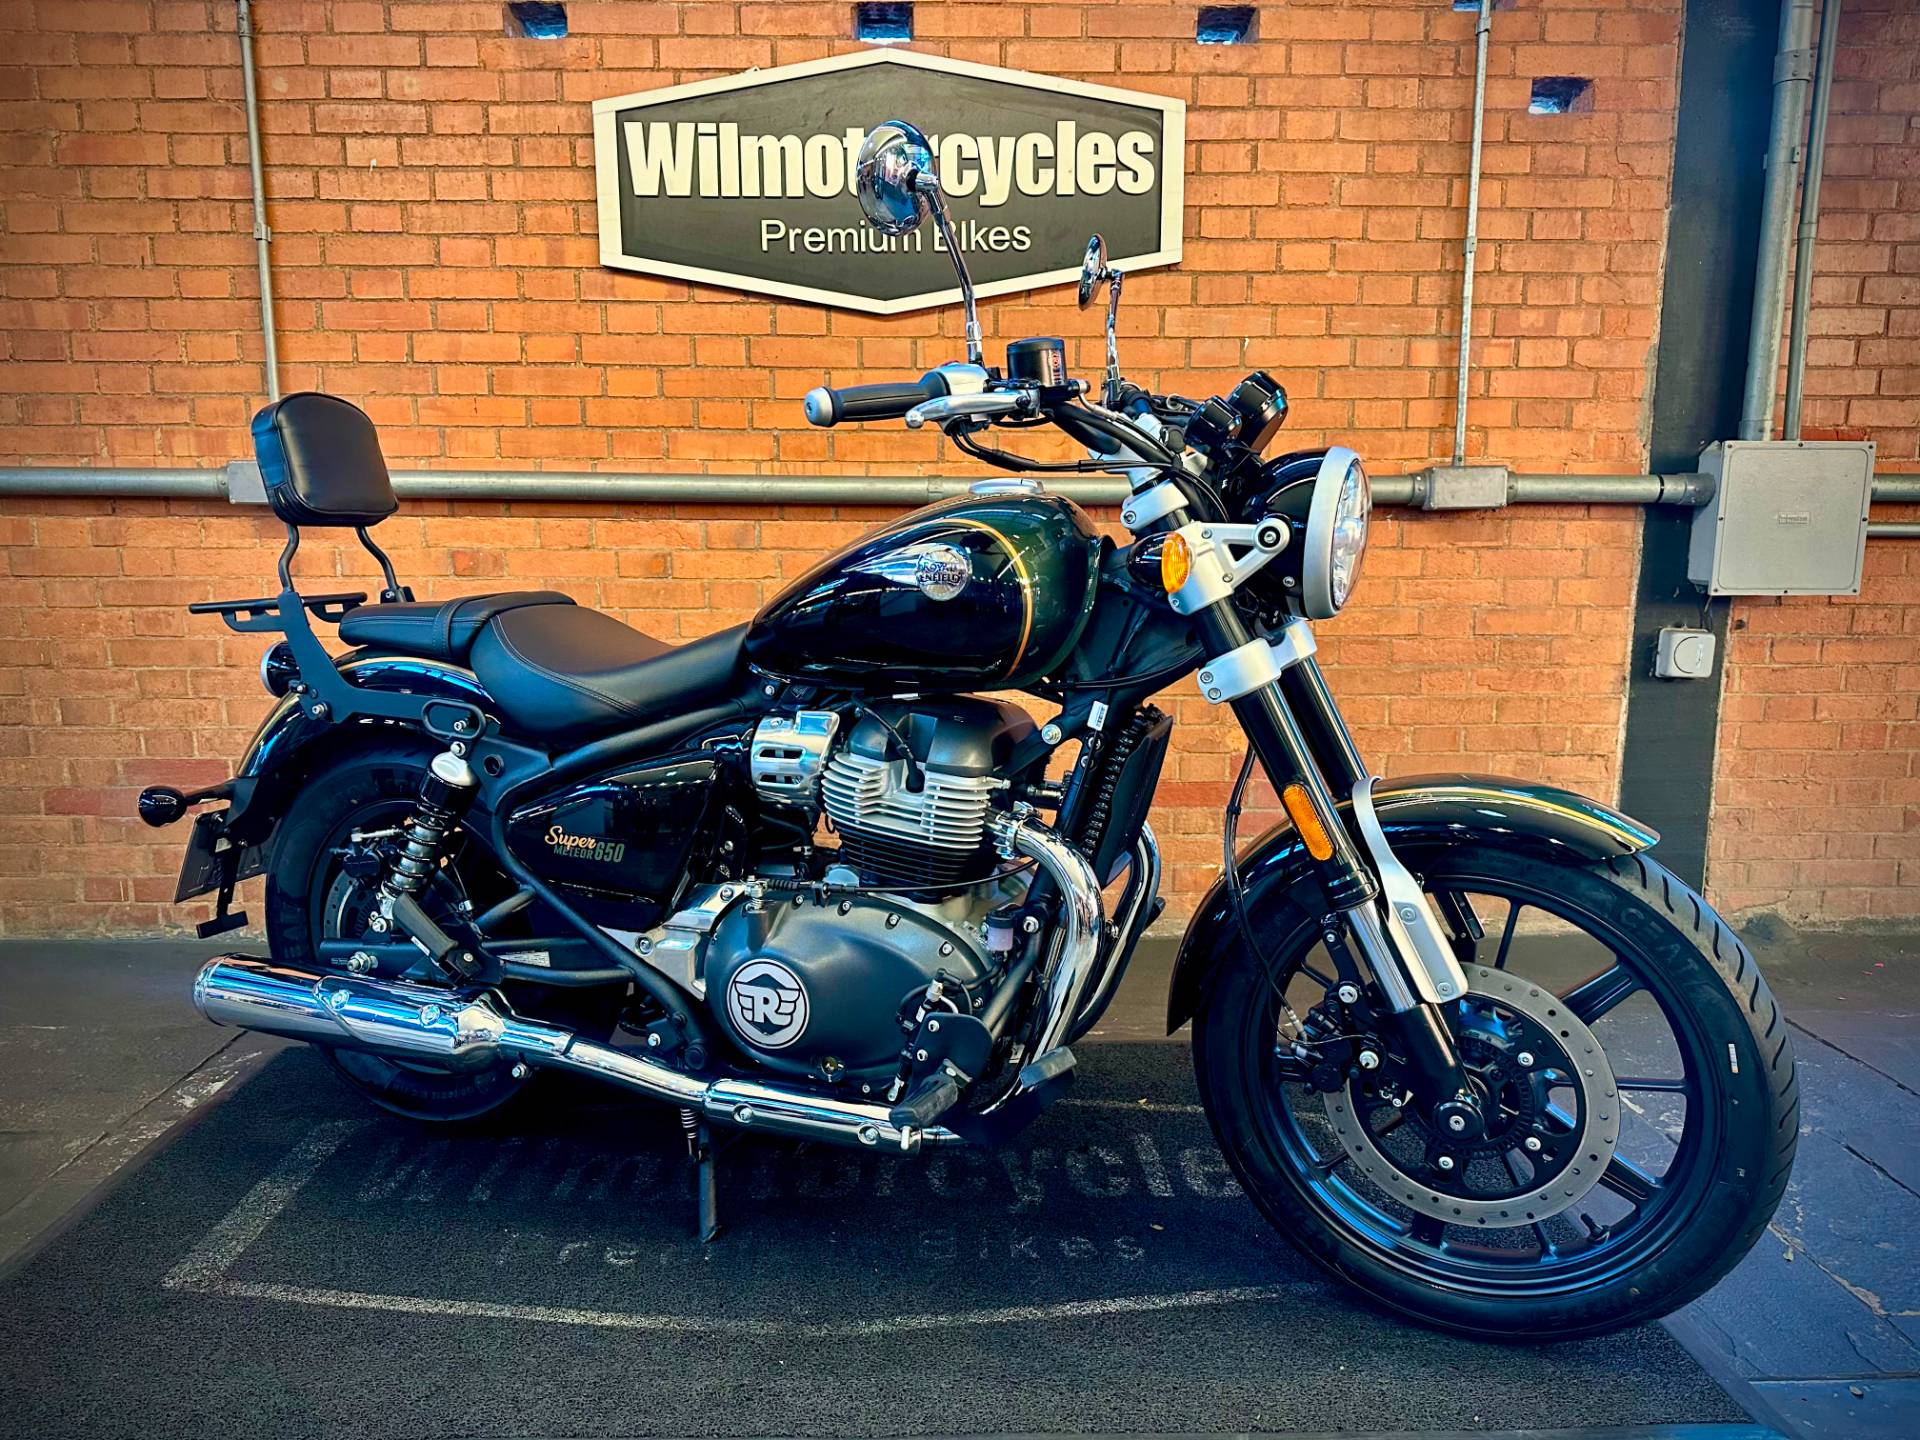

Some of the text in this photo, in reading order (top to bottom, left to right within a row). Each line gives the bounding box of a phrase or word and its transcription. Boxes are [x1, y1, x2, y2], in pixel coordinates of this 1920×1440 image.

[623, 120, 1155, 206] Wilmotcycles
[761, 218, 1032, 252] Premium Bikes
[919, 573, 961, 585] ENFIELD
[544, 825, 597, 850] Super
[554, 841, 625, 863] METEOR 650
